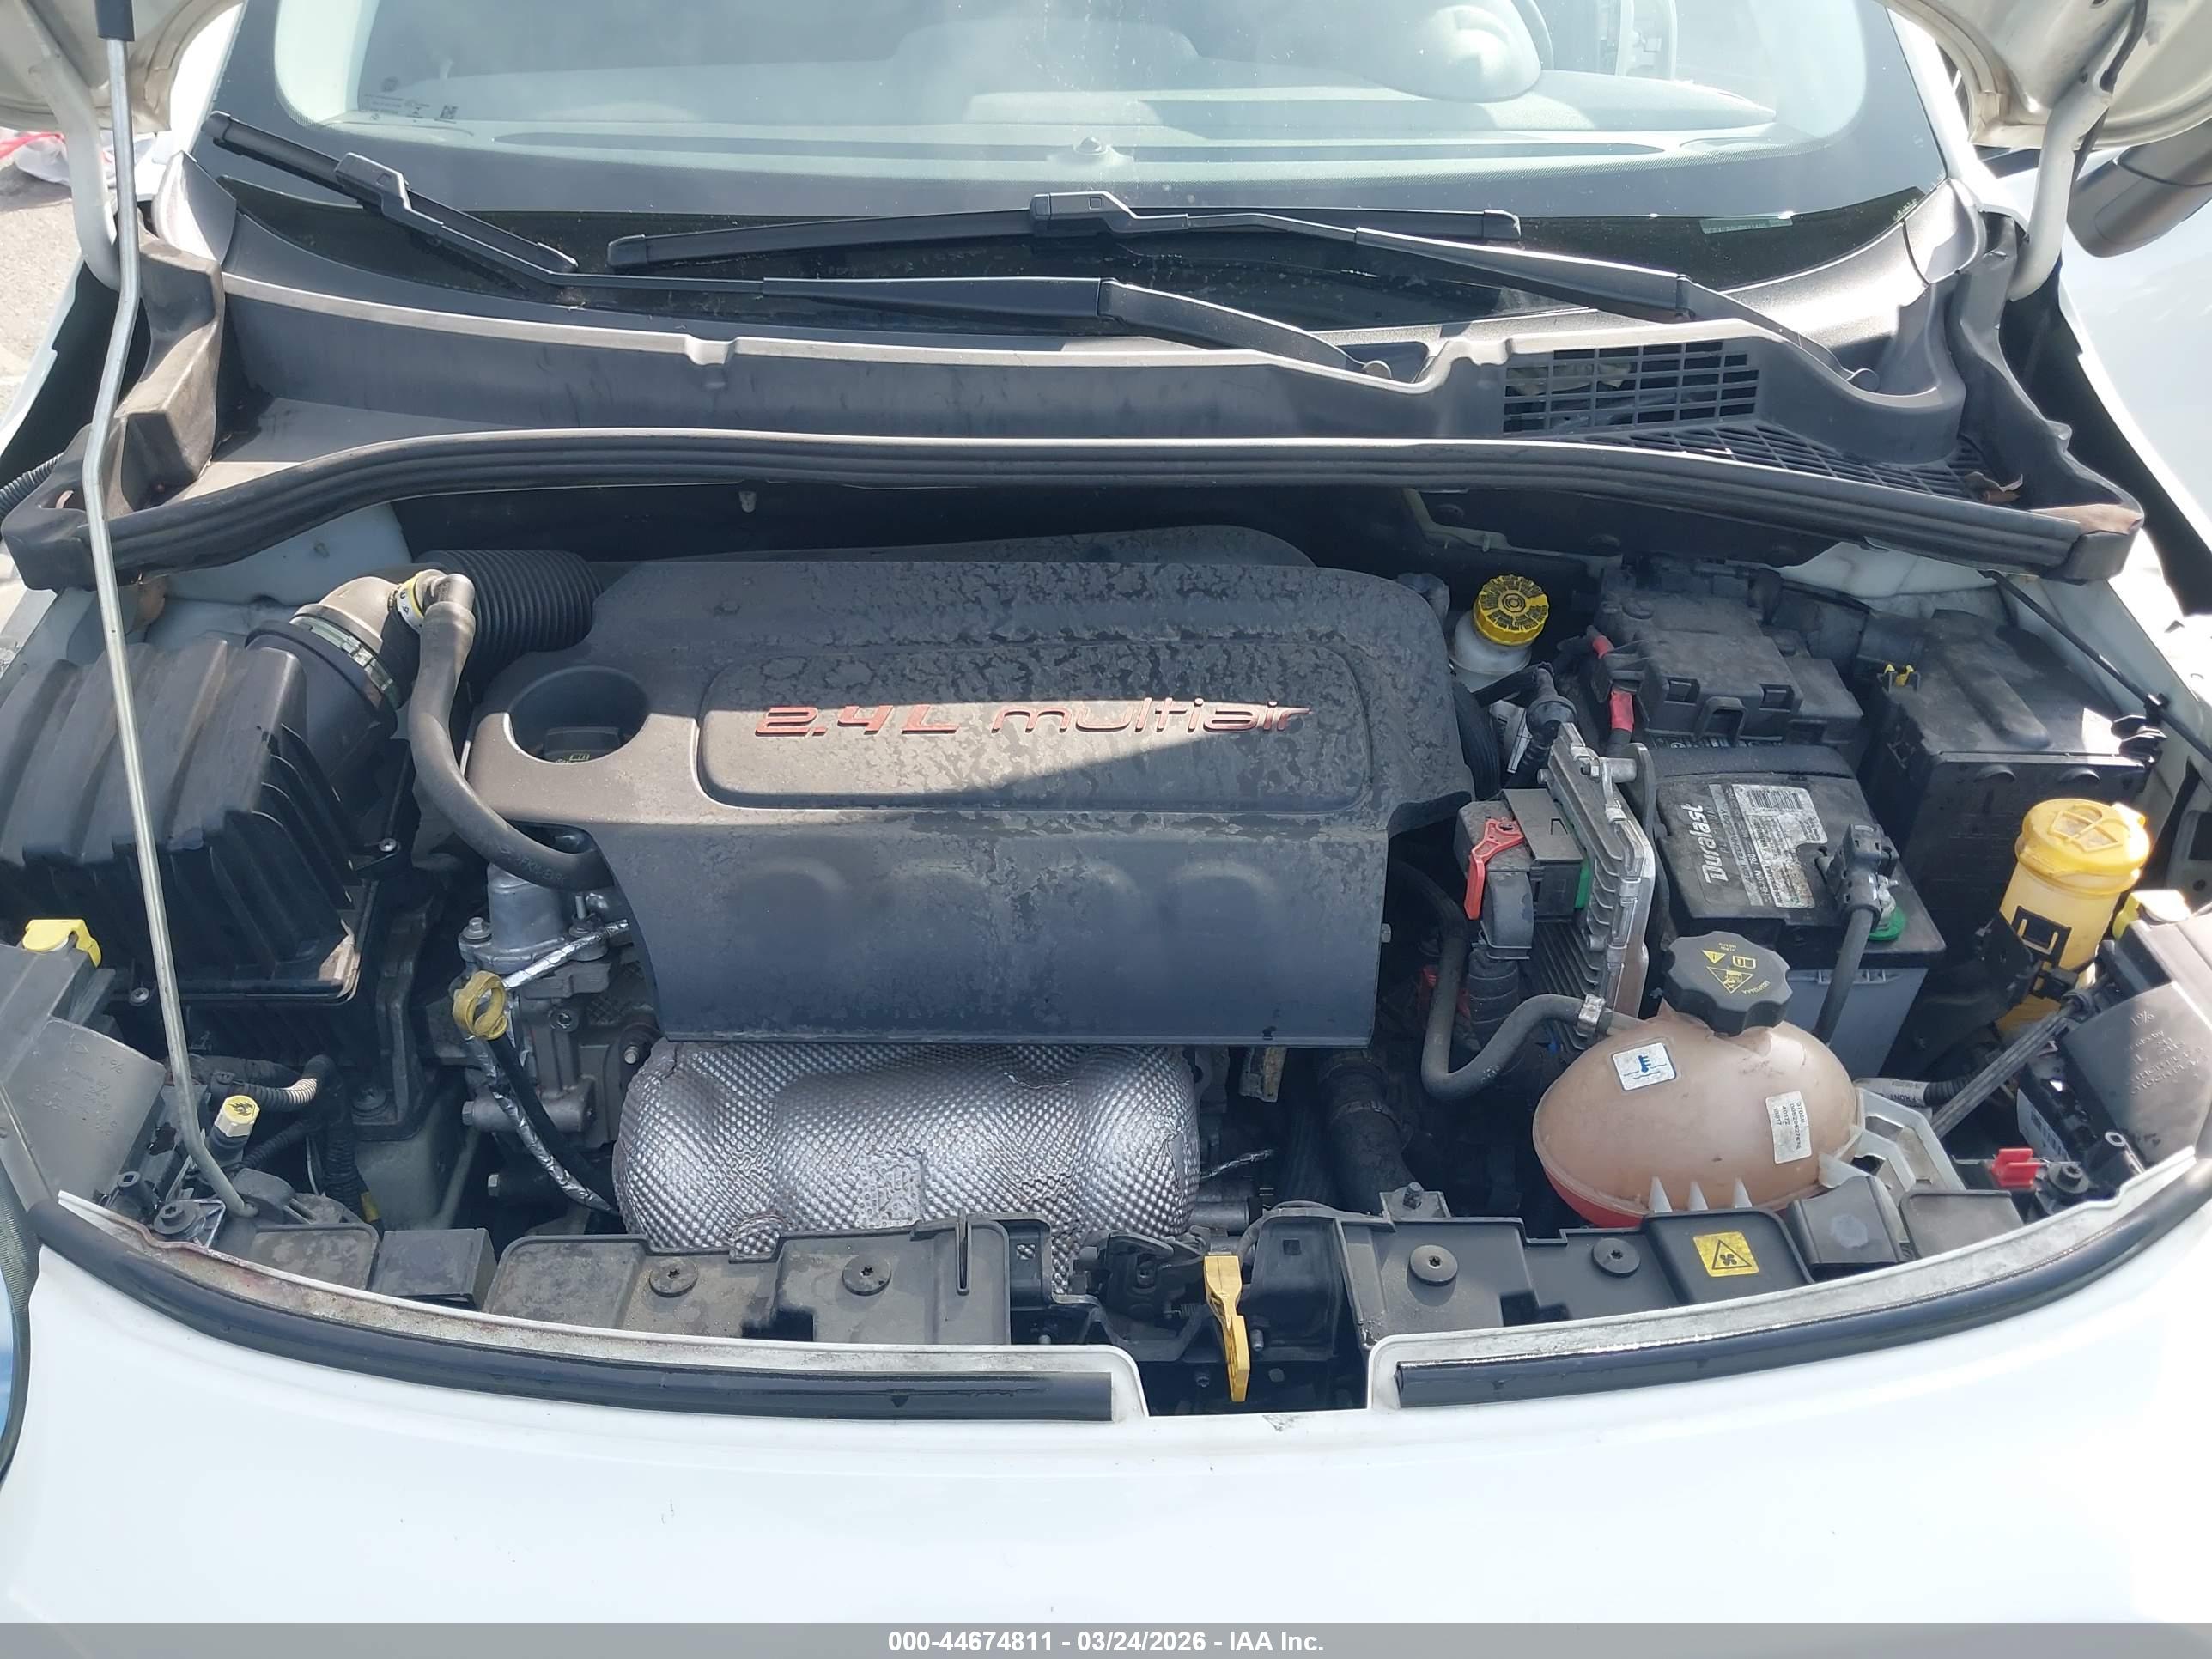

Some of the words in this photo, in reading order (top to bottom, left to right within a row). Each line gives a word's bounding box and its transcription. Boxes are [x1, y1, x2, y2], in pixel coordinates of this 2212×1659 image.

[991, 696, 1310, 734] multiair
[1680, 803, 1729, 883] Duralast
[1747, 853, 1759, 865] 760
